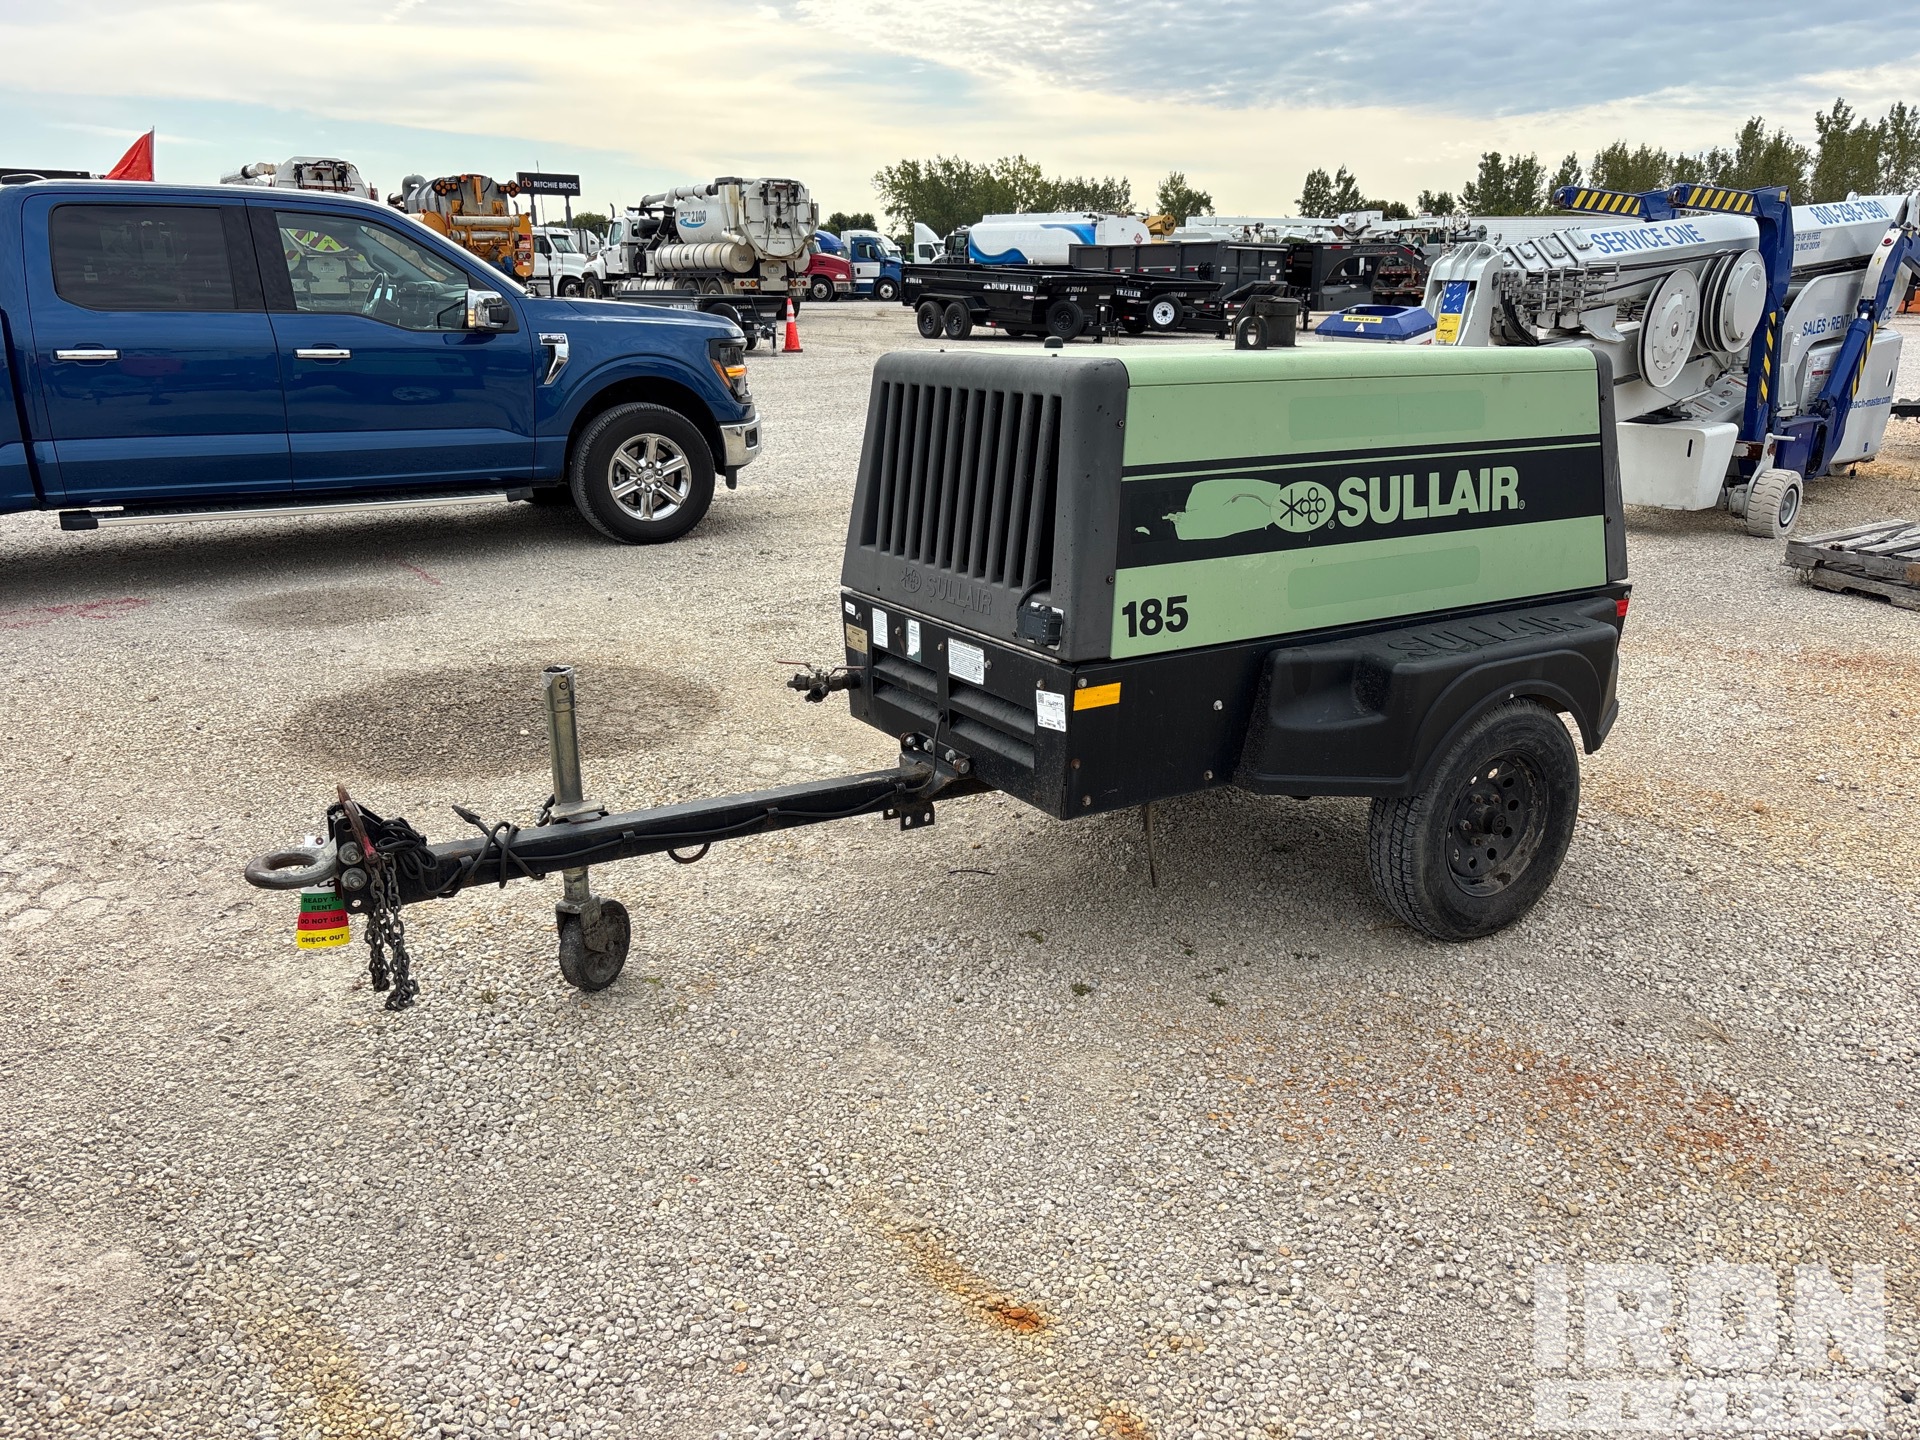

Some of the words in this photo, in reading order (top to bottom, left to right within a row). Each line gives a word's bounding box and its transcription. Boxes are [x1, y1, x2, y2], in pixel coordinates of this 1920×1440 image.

[533, 181, 558, 189] RITCHIE
[691, 210, 707, 222] 2100
[1808, 200, 1890, 225] 800-298-7990
[1590, 227, 1671, 254] SERVICE
[1664, 223, 1706, 245] ONE
[991, 283, 1009, 291] DUMP
[1009, 284, 1034, 293] TRAILER
[1116, 289, 1141, 298] TRAILER
[1802, 317, 1826, 337] SALES
[1338, 466, 1520, 528] SULLAIR
[926, 573, 992, 615] SULLAIR
[1122, 595, 1188, 638] 185
[1387, 616, 1591, 658] SULLAIR
